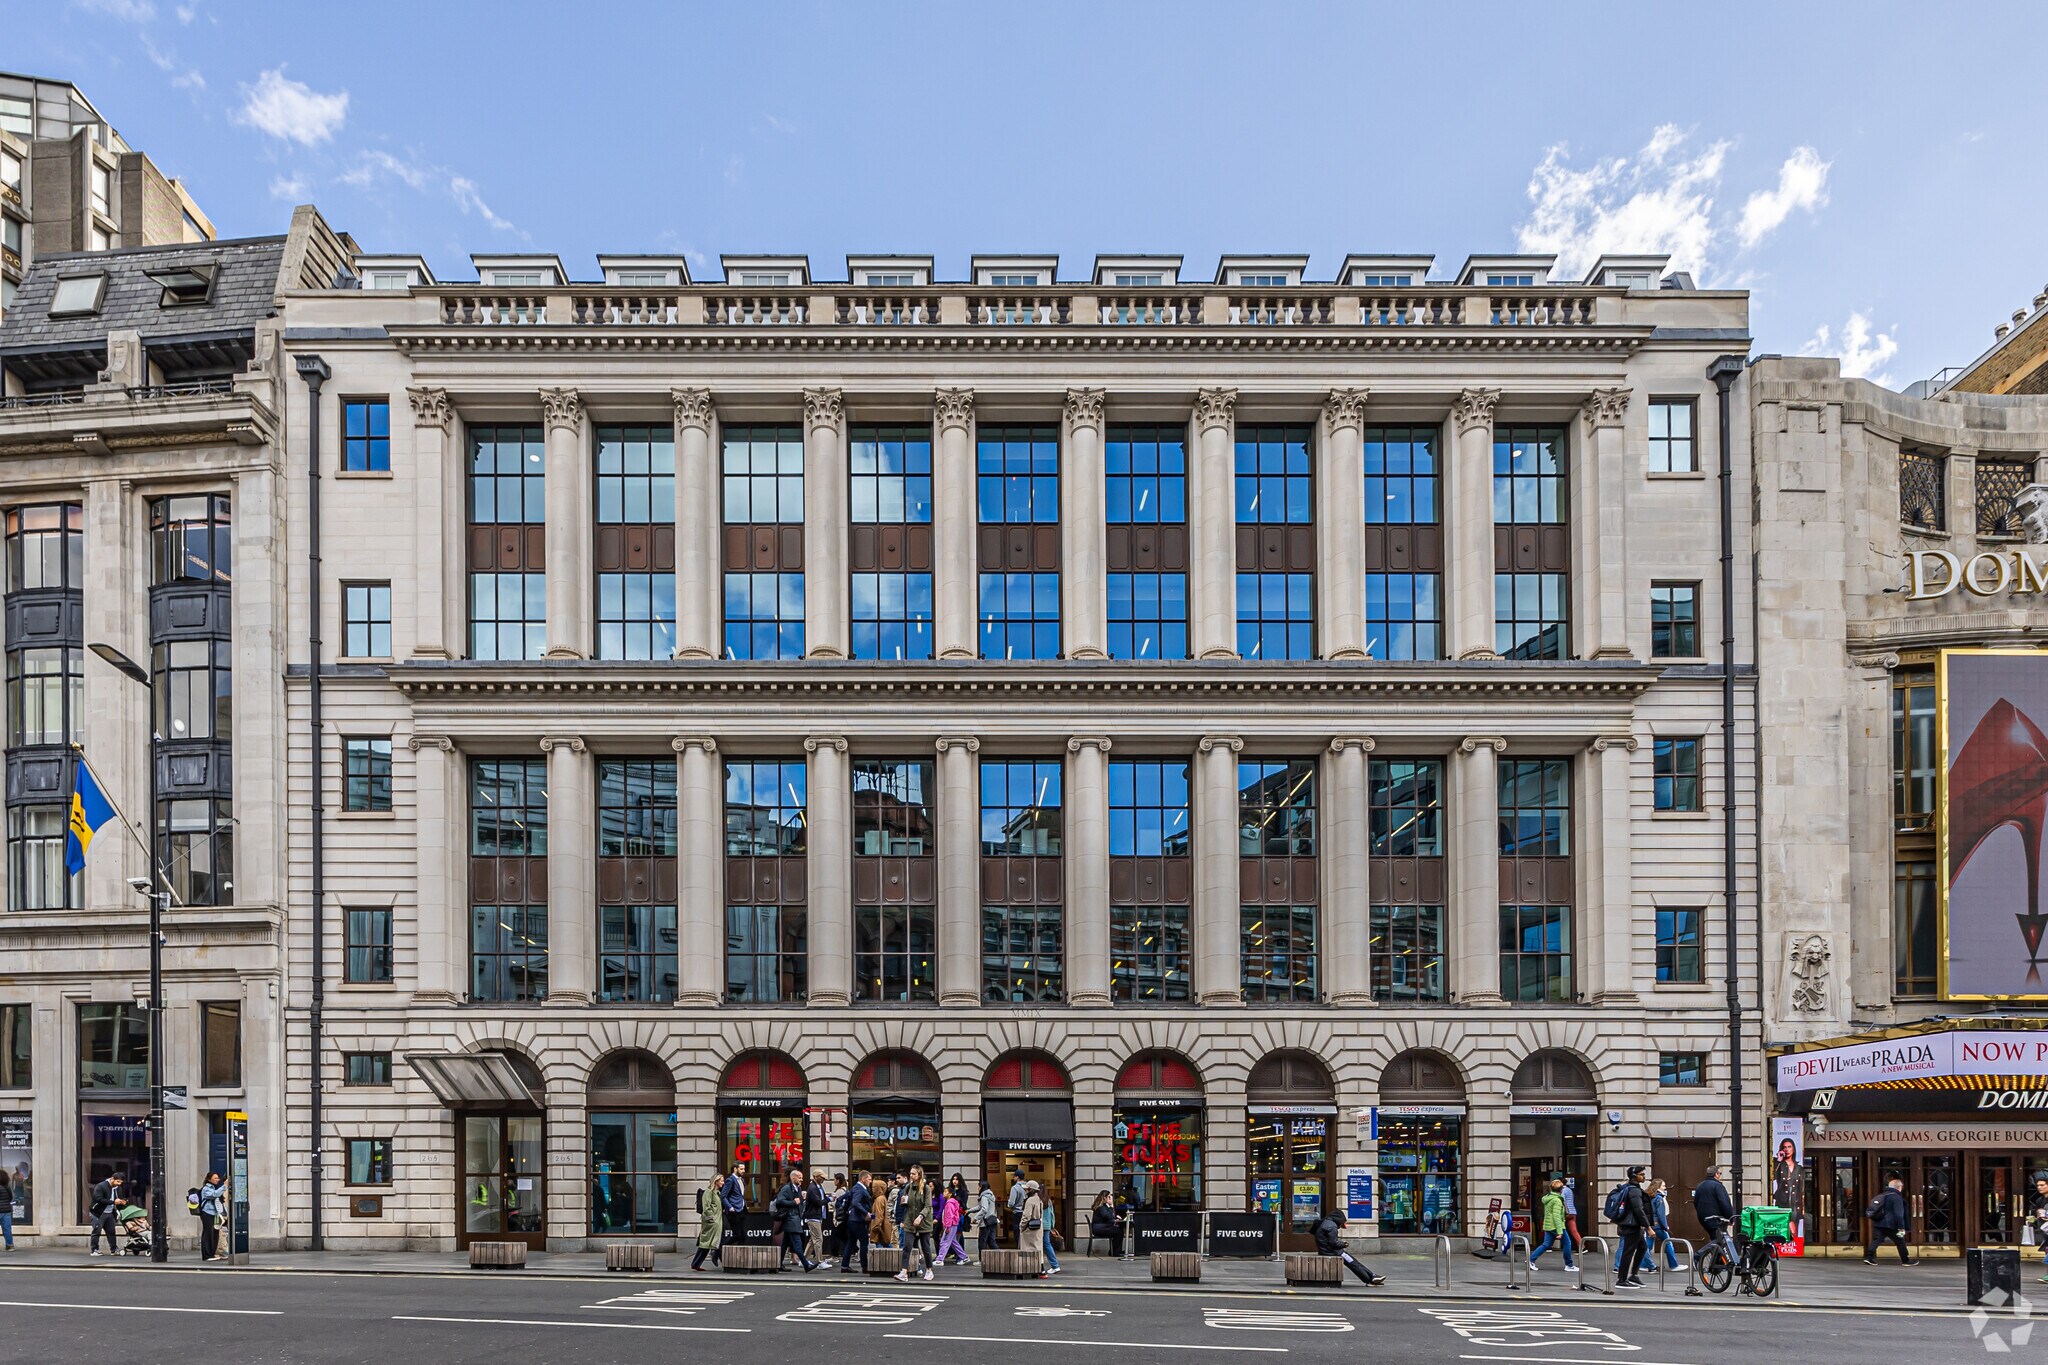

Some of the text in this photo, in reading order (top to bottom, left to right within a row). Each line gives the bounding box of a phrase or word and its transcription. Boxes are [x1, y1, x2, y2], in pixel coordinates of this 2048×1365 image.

[1962, 1042, 2048, 1062] NOW P
[1782, 1044, 1935, 1085] THE DEVIL WEARS PRADA
[1887, 1065, 1903, 1073] NEW
[1904, 1061, 1936, 1072] MUSICAL
[1815, 1093, 1831, 1106] N
[1977, 1090, 2048, 1109] DOMI
[739, 1122, 795, 1140] FIVE
[1127, 1122, 1182, 1141] FIVE
[1861, 1130, 1933, 1143] WILLIAMS,
[1936, 1130, 2000, 1142] GEORGIE
[735, 1143, 803, 1162] GUYS
[1121, 1143, 1191, 1164] GUYS
[747, 1229, 772, 1237] GUYS
[1238, 1230, 1263, 1238] GUYS
[579, 1290, 755, 1314] ONLY
[775, 1291, 951, 1324] AHEAD
[1201, 1307, 1356, 1332] AND
[1417, 1307, 1642, 1351] BUSES
